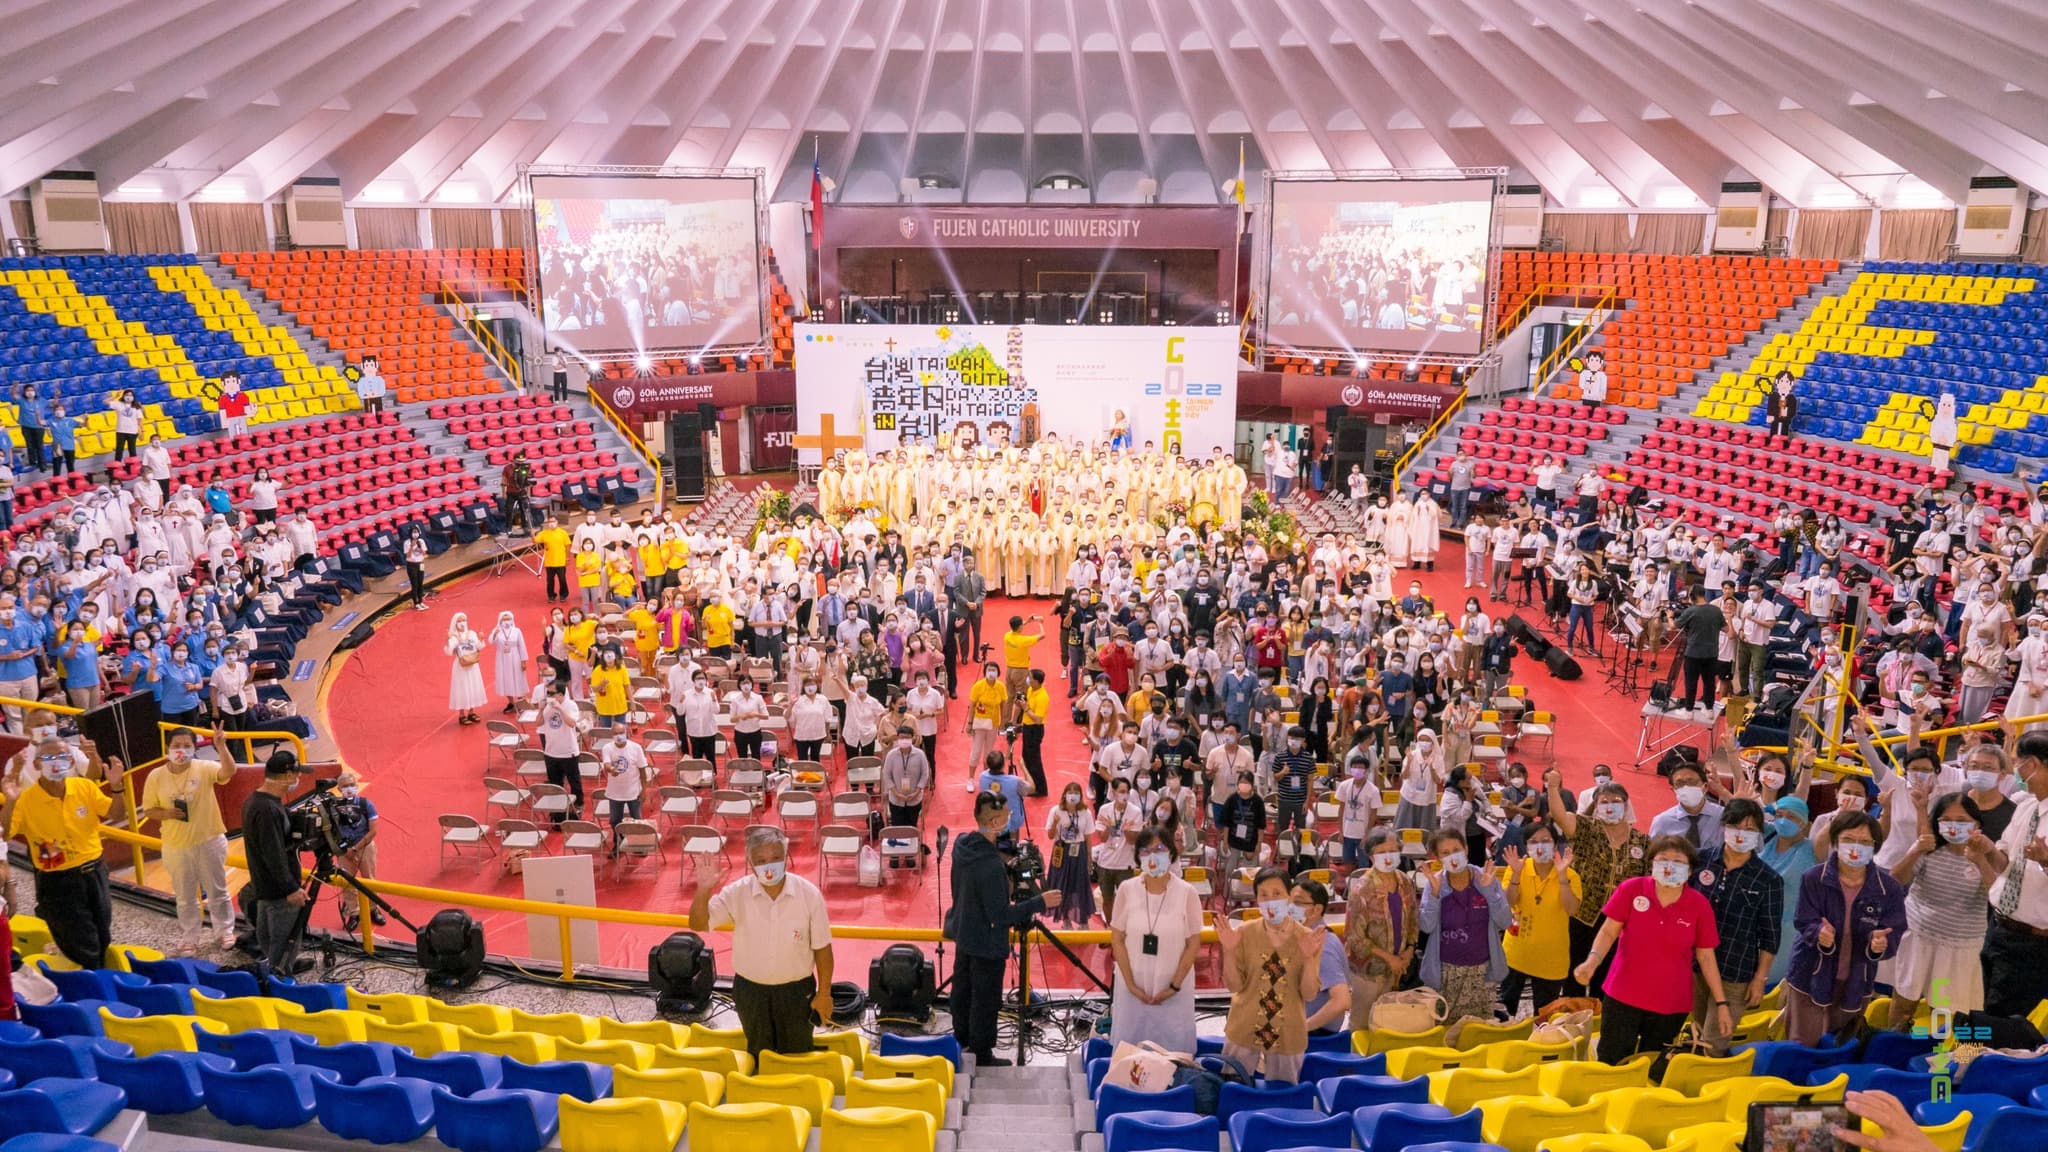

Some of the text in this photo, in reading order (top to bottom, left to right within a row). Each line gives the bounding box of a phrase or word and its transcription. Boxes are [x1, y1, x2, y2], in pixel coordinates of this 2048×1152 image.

[934, 219, 1141, 237] FUJEN CATHOLIC UNIVERSITY
[945, 372, 1010, 386] YOUTH
[640, 385, 713, 397] 60th ANNIVERSARY
[872, 385, 944, 411] 青年日
[945, 388, 1038, 401] DAY 2022
[1367, 390, 1386, 399] 60th
[1387, 392, 1442, 404] ANNIVERSARY
[898, 413, 946, 438] 台北
